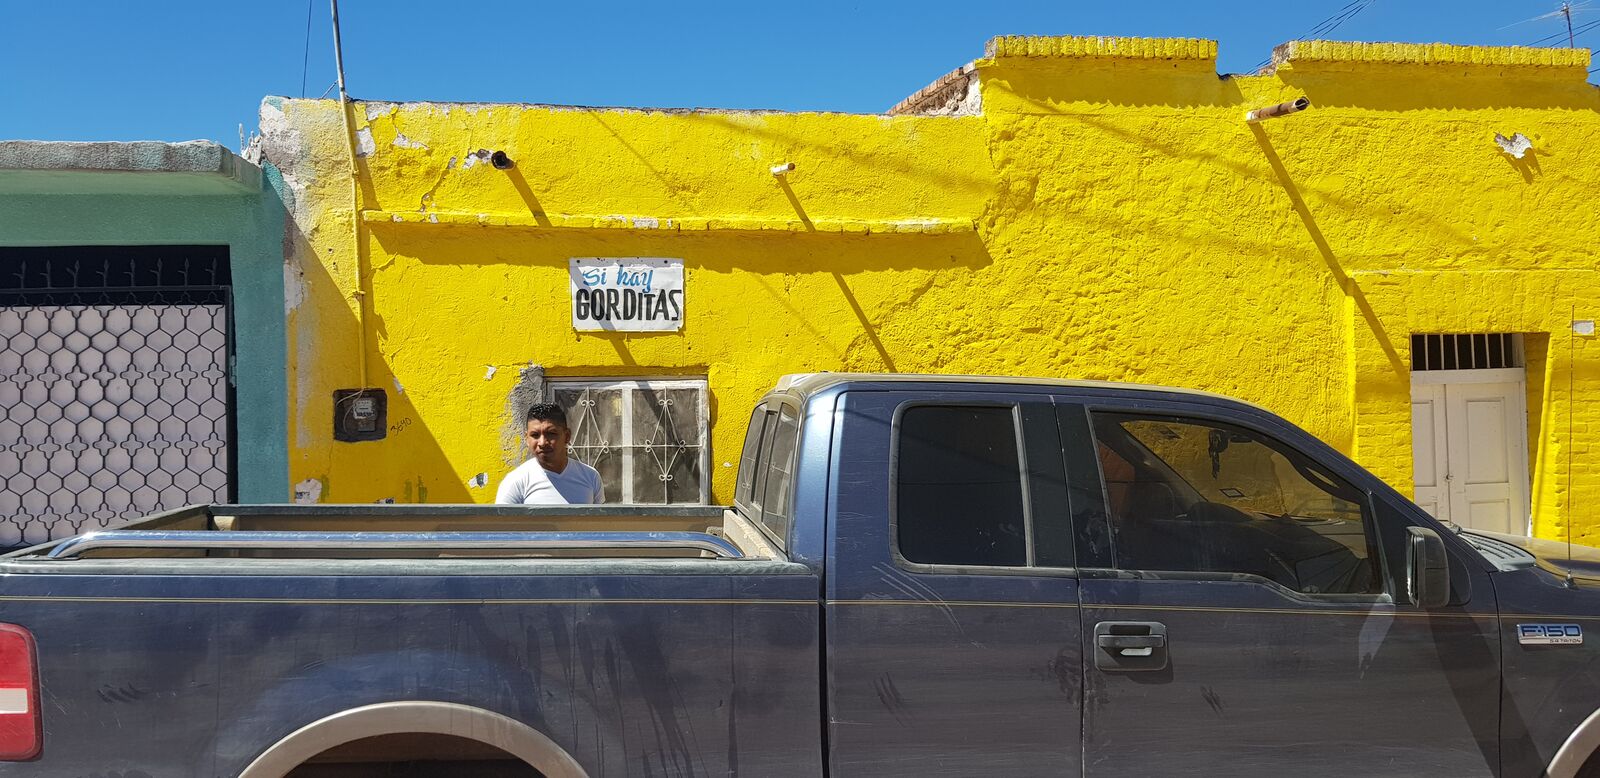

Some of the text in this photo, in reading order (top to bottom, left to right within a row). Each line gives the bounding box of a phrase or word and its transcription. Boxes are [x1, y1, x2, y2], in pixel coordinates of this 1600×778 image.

[582, 264, 653, 293] Si hay
[576, 288, 682, 321] GORDITAS
[1520, 625, 1581, 637] F-150
